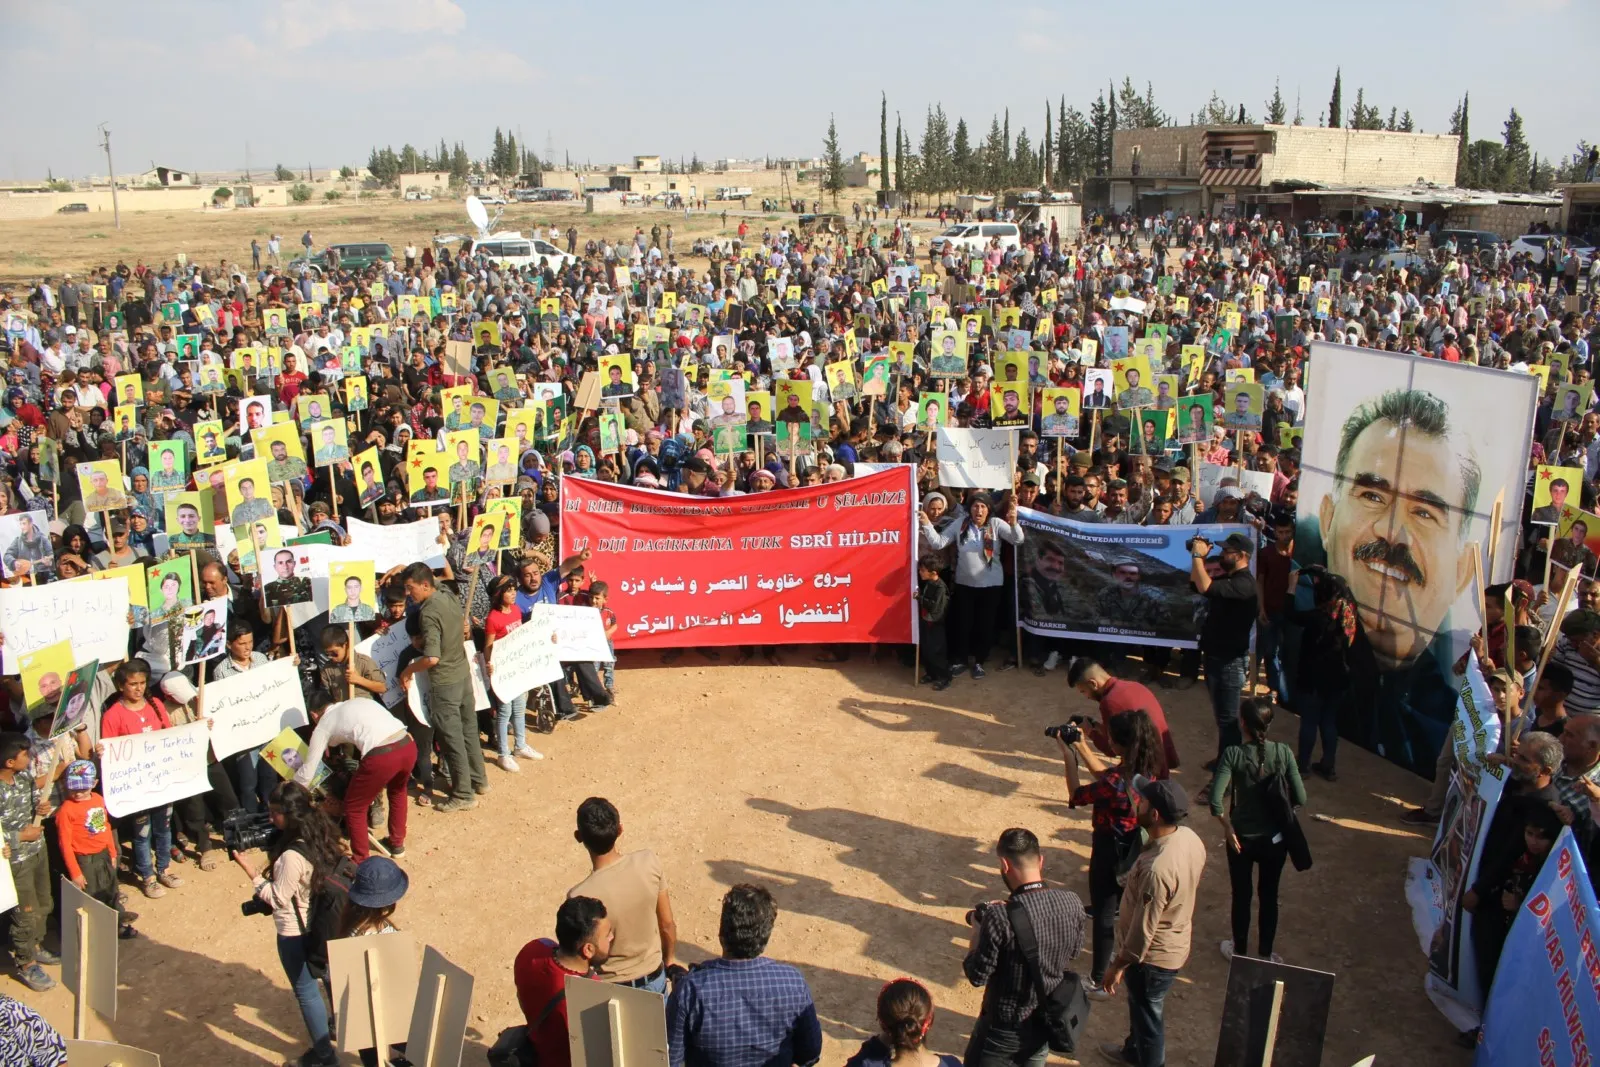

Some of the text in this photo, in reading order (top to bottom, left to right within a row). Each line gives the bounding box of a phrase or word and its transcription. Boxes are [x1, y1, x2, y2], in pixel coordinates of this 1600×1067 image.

[704, 575, 749, 595] العصر
[756, 573, 804, 593] مقاومة
[813, 572, 852, 588] بروح
[626, 614, 674, 638] التركي
[738, 609, 763, 626] ضد
[109, 733, 196, 764] NO for Turkish
[162, 755, 174, 764] on
[180, 750, 194, 759] the
[109, 783, 132, 796] North
